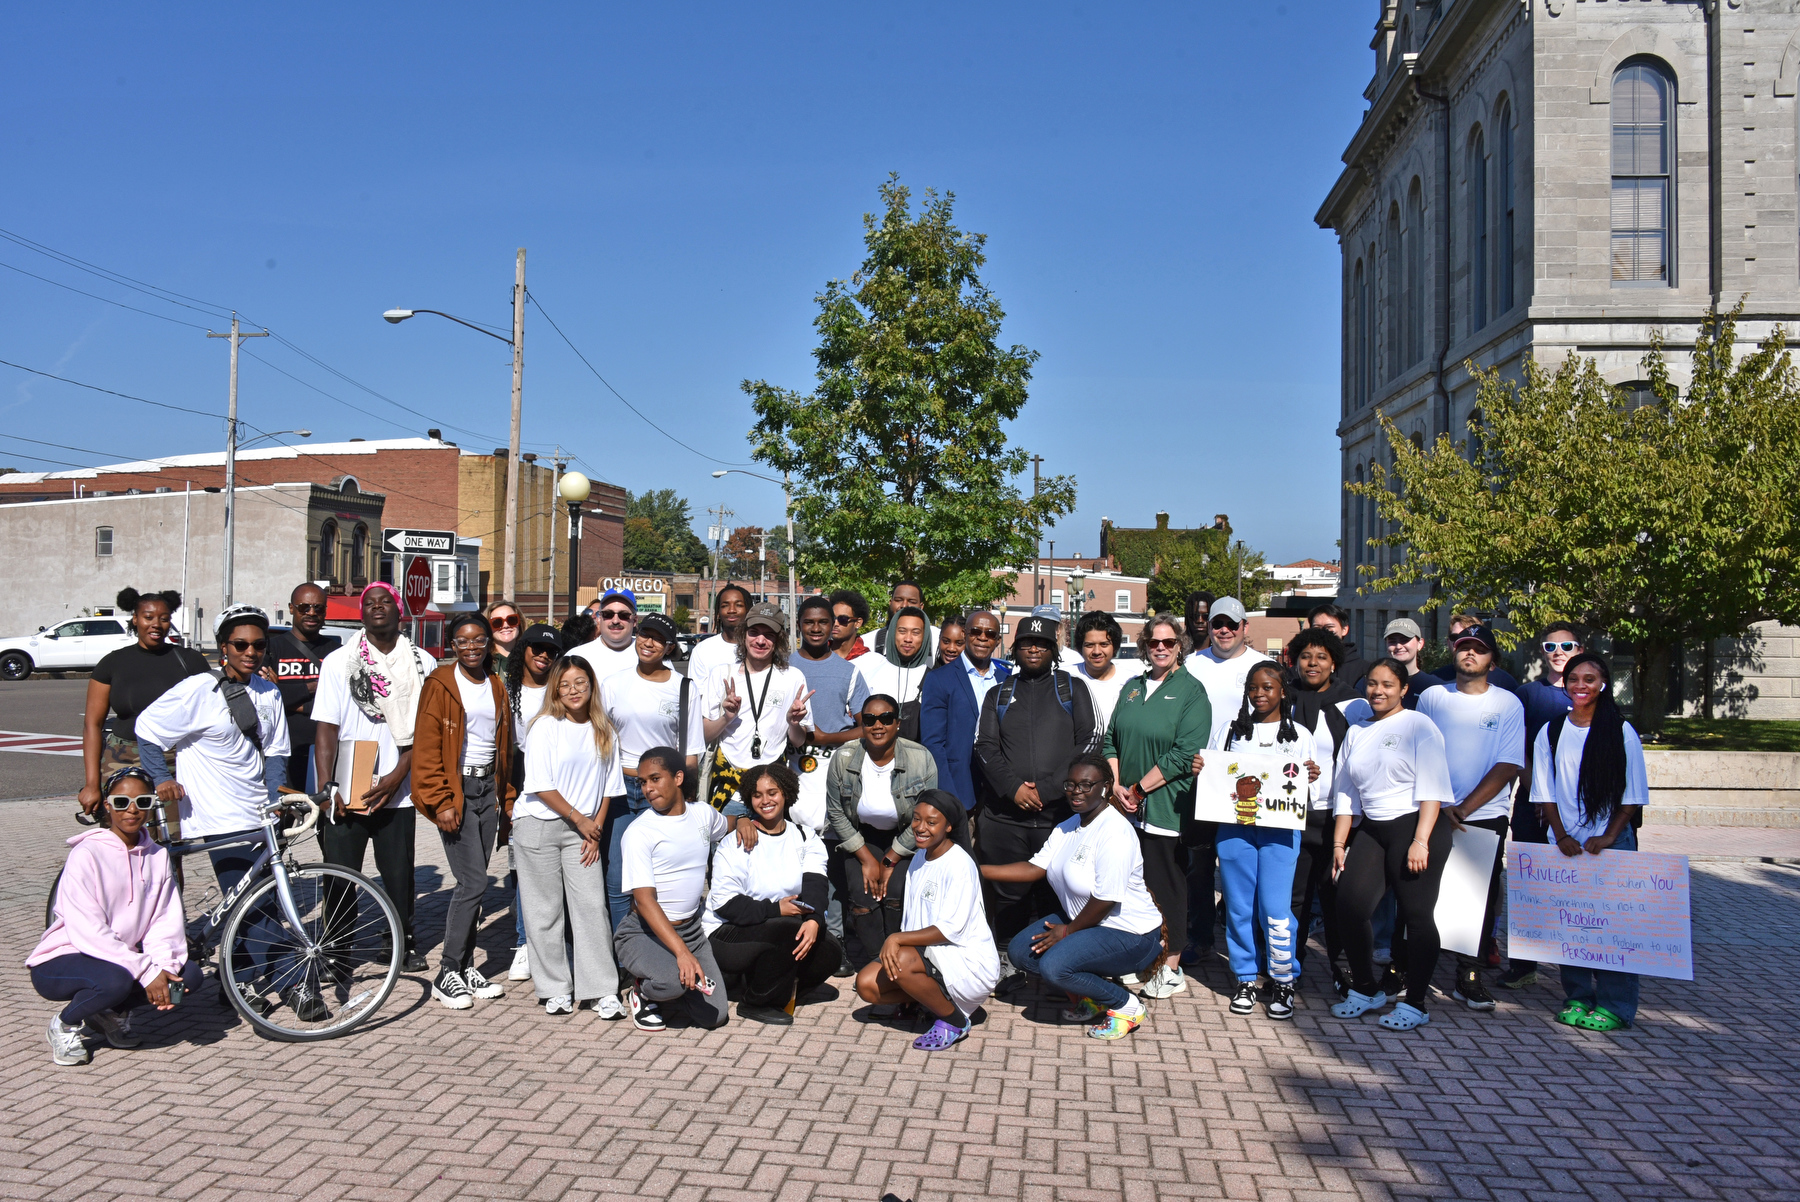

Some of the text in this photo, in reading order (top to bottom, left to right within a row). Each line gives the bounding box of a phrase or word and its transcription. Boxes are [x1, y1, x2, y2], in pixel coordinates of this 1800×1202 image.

[404, 537, 447, 548] ONE WAY
[407, 574, 431, 598] STOP
[603, 577, 663, 592] OSWEGO
[1030, 619, 1043, 633] NY
[278, 662, 305, 676] DR.
[1265, 797, 1306, 820] unity
[1650, 874, 1674, 891] YOU
[1509, 889, 1543, 905] Think
[1550, 894, 1596, 916] Something
[1617, 902, 1635, 912] not
[1639, 903, 1647, 912] a
[1510, 921, 1543, 940] Because
[1571, 934, 1590, 945] not
[1597, 936, 1604, 945] a
[1650, 940, 1661, 952] to
[1267, 915, 1294, 983] MIAMI
[1561, 942, 1626, 966] PERSONALLY
